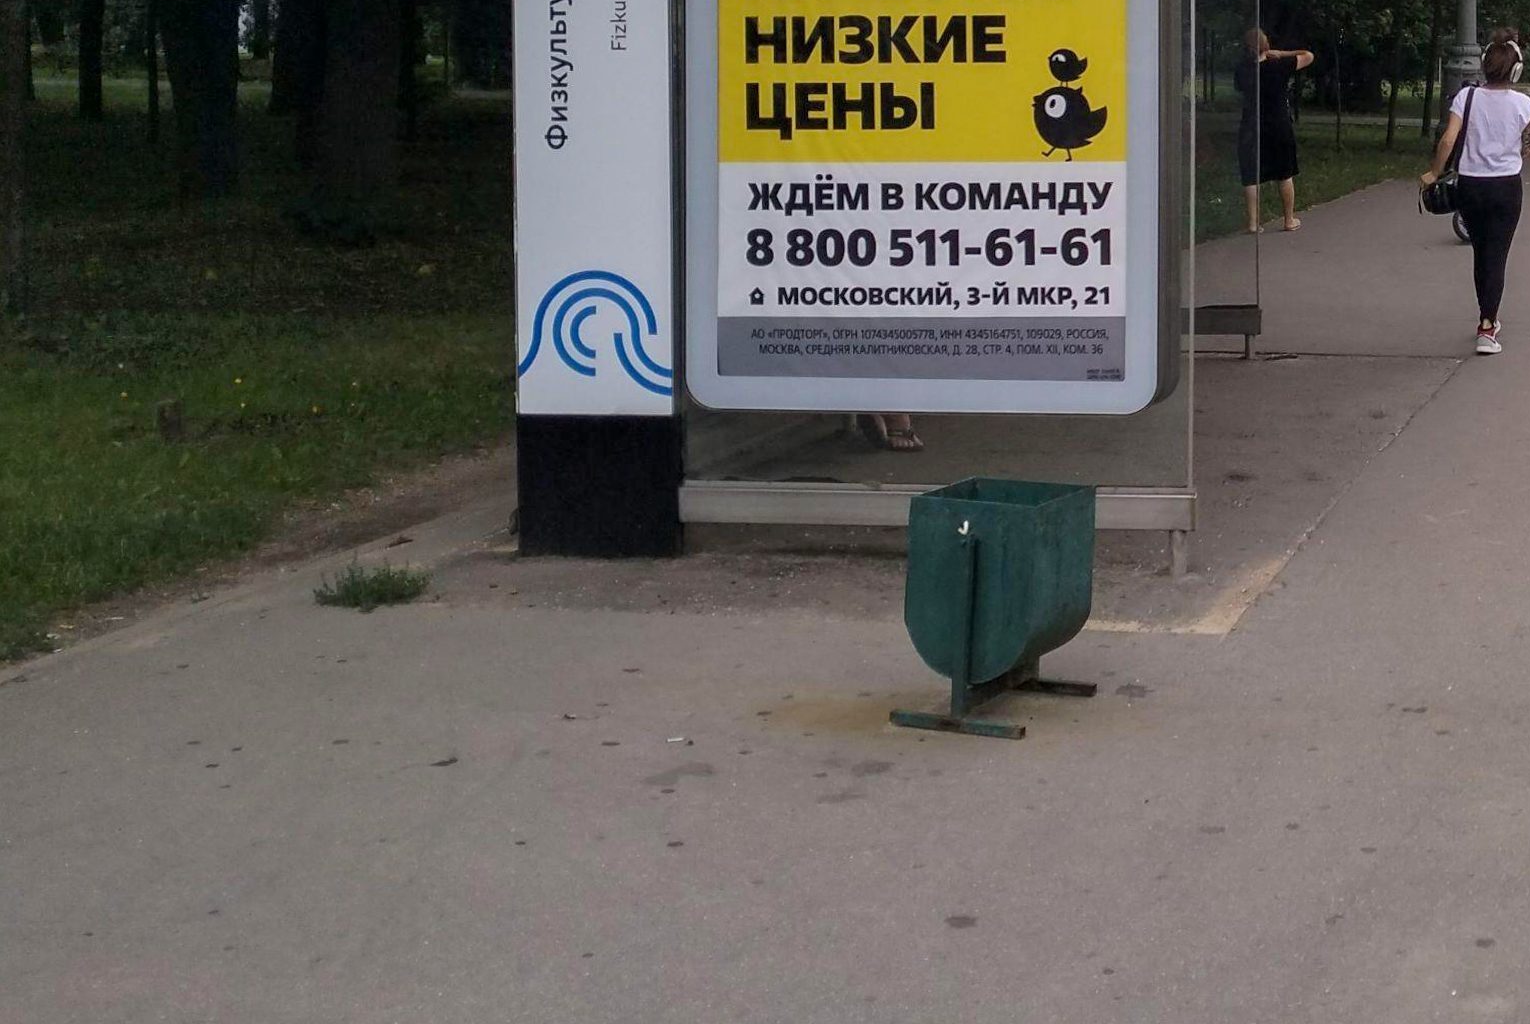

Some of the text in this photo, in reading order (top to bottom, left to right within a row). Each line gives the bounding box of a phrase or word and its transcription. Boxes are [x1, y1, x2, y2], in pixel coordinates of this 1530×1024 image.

[745, 15, 1007, 64] НИЗКИЕ
[745, 82, 935, 140] ЦЕНЫ
[748, 174, 1113, 216] ЖДЁМ В КОМАНДУ
[746, 228, 1111, 266] 8 800 511-61-61
[777, 281, 1110, 309] МОСКОВСКИЙ, 3-Й МКР, 21
[751, 329, 765, 339] АО
[833, 329, 858, 339] ОГРН
[940, 329, 962, 339] ИНН
[1066, 329, 1109, 340] РОССИЯ,
[759, 344, 803, 356] МОСКВА,
[805, 344, 850, 356] СРЕДНЯЯ
[966, 345, 981, 356] 28,
[1005, 345, 1015, 356] 4,
[1091, 345, 1103, 354] 36
